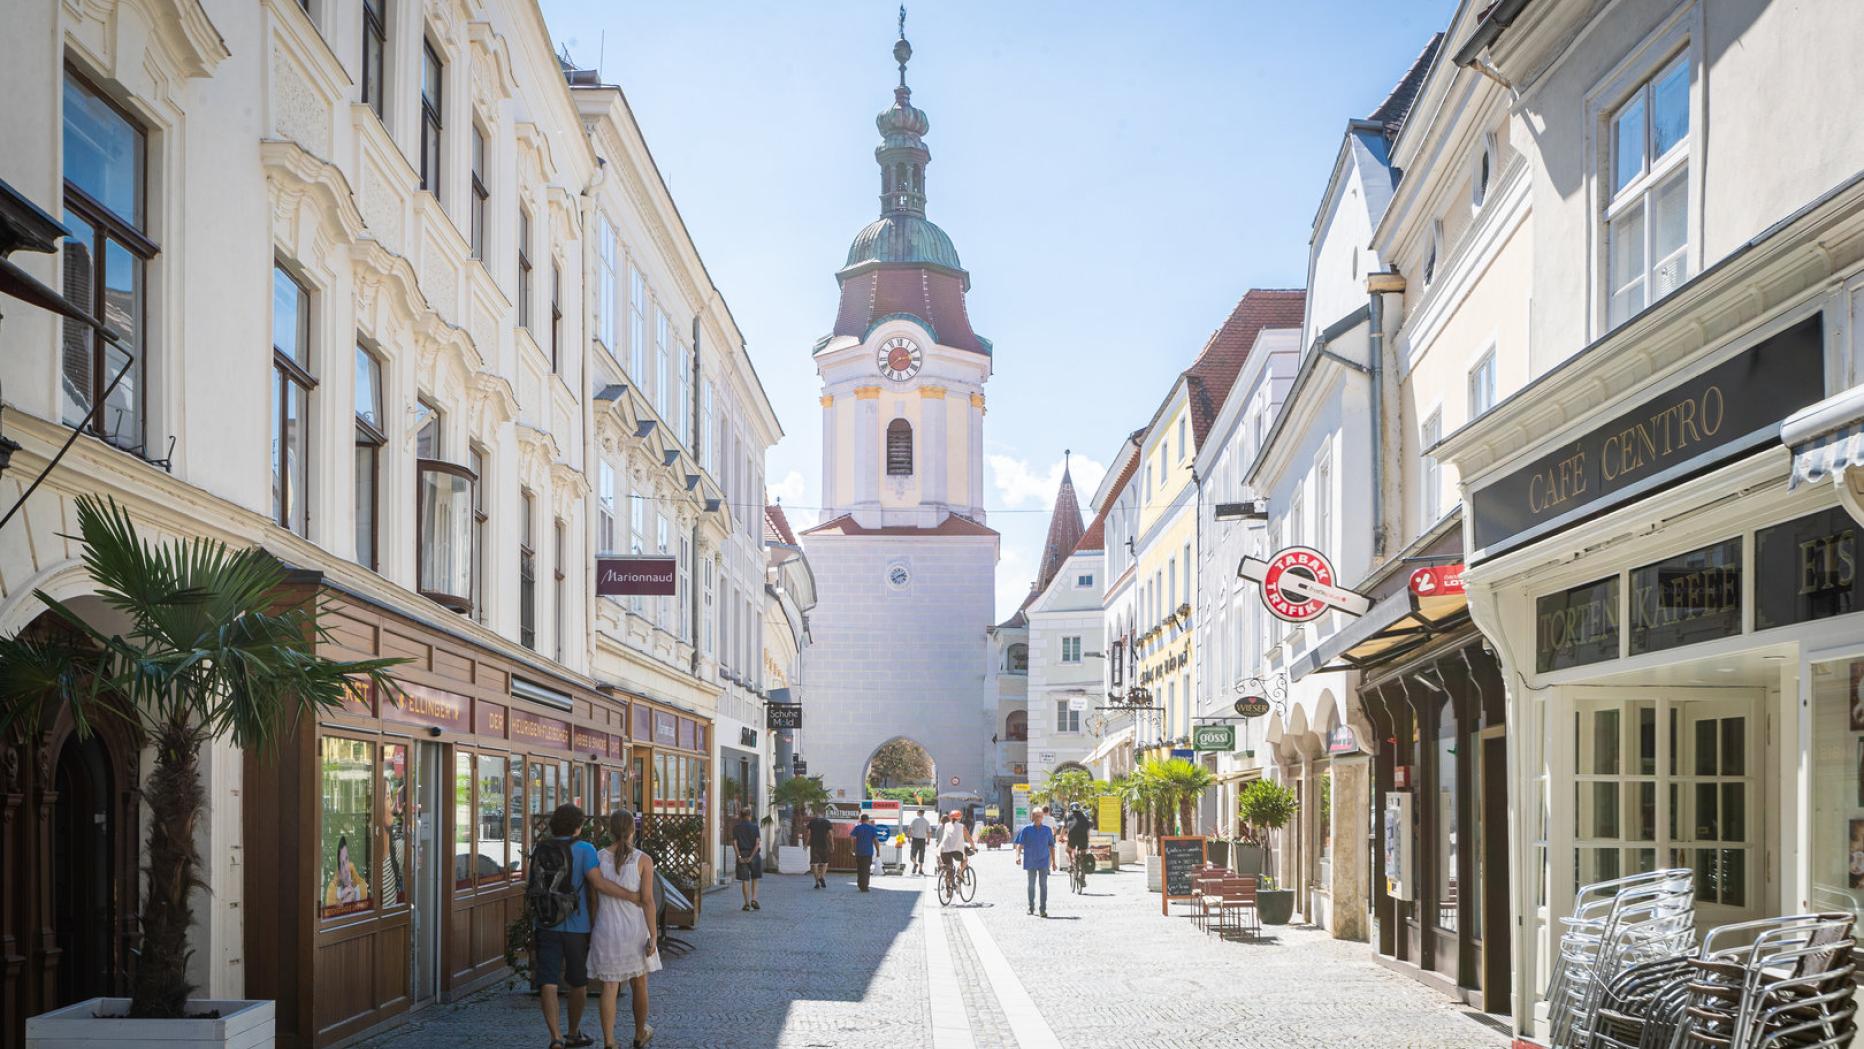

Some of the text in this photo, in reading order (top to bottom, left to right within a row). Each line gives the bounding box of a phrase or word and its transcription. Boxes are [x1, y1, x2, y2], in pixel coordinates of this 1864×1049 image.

[1528, 385, 1725, 514] CAFÉ CENTRO
[1274, 553, 1329, 579] TABAK
[1798, 529, 1857, 595] EIS
[600, 569, 673, 584] Marionnaud
[1266, 582, 1318, 616] TRAFIK
[1634, 565, 1739, 632] KAFFEE
[1540, 594, 1620, 653] TORTEN
[410, 695, 451, 720] ELLINGER
[770, 709, 799, 719] Schuhe
[1236, 702, 1268, 713] WIESER
[489, 712, 503, 731] DER
